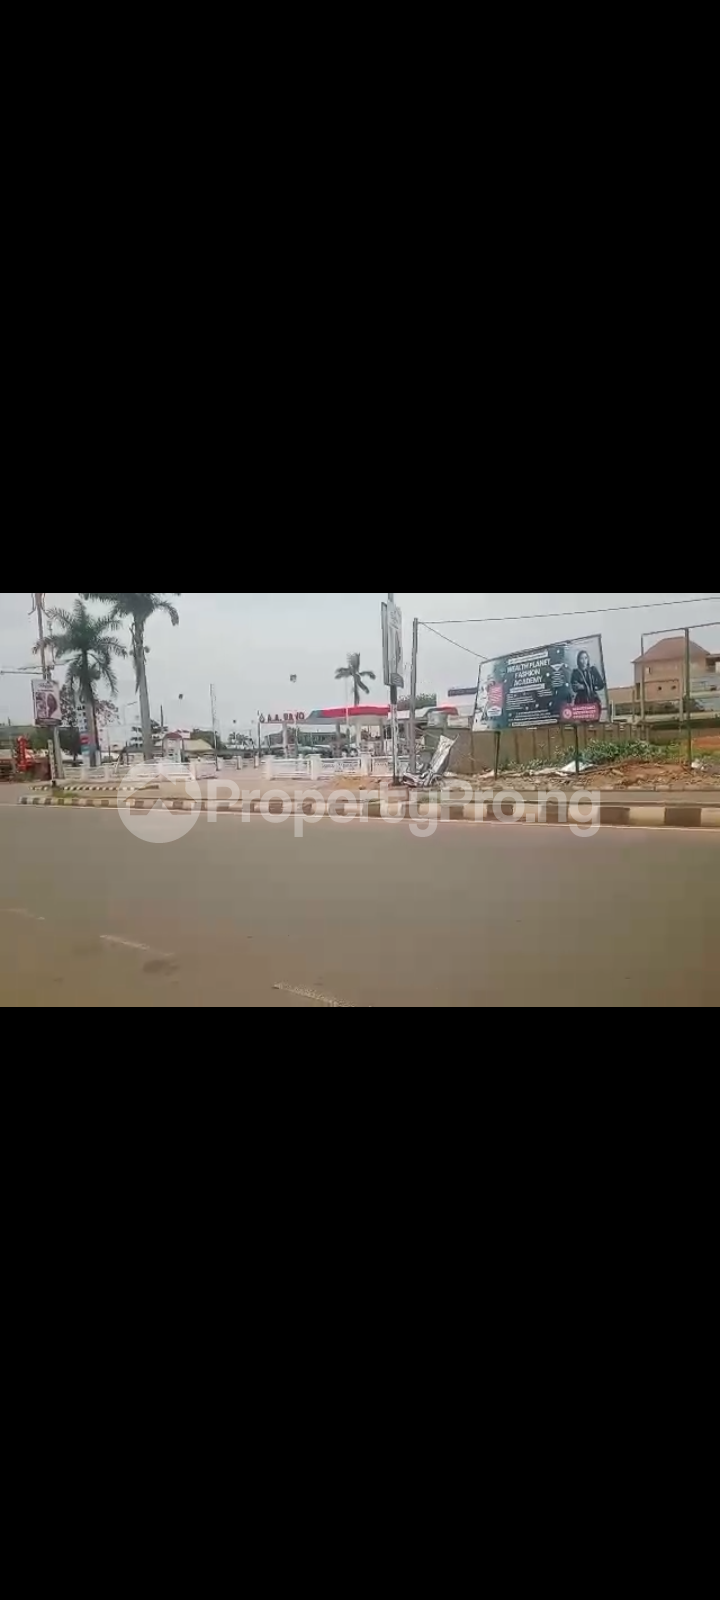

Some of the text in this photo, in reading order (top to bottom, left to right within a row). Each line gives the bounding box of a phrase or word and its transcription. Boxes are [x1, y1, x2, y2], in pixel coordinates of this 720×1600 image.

[507, 663, 529, 673] WEALTH
[529, 659, 551, 669] PLANET
[515, 670, 540, 678] FASHION
[514, 677, 542, 686] ACADEMY
